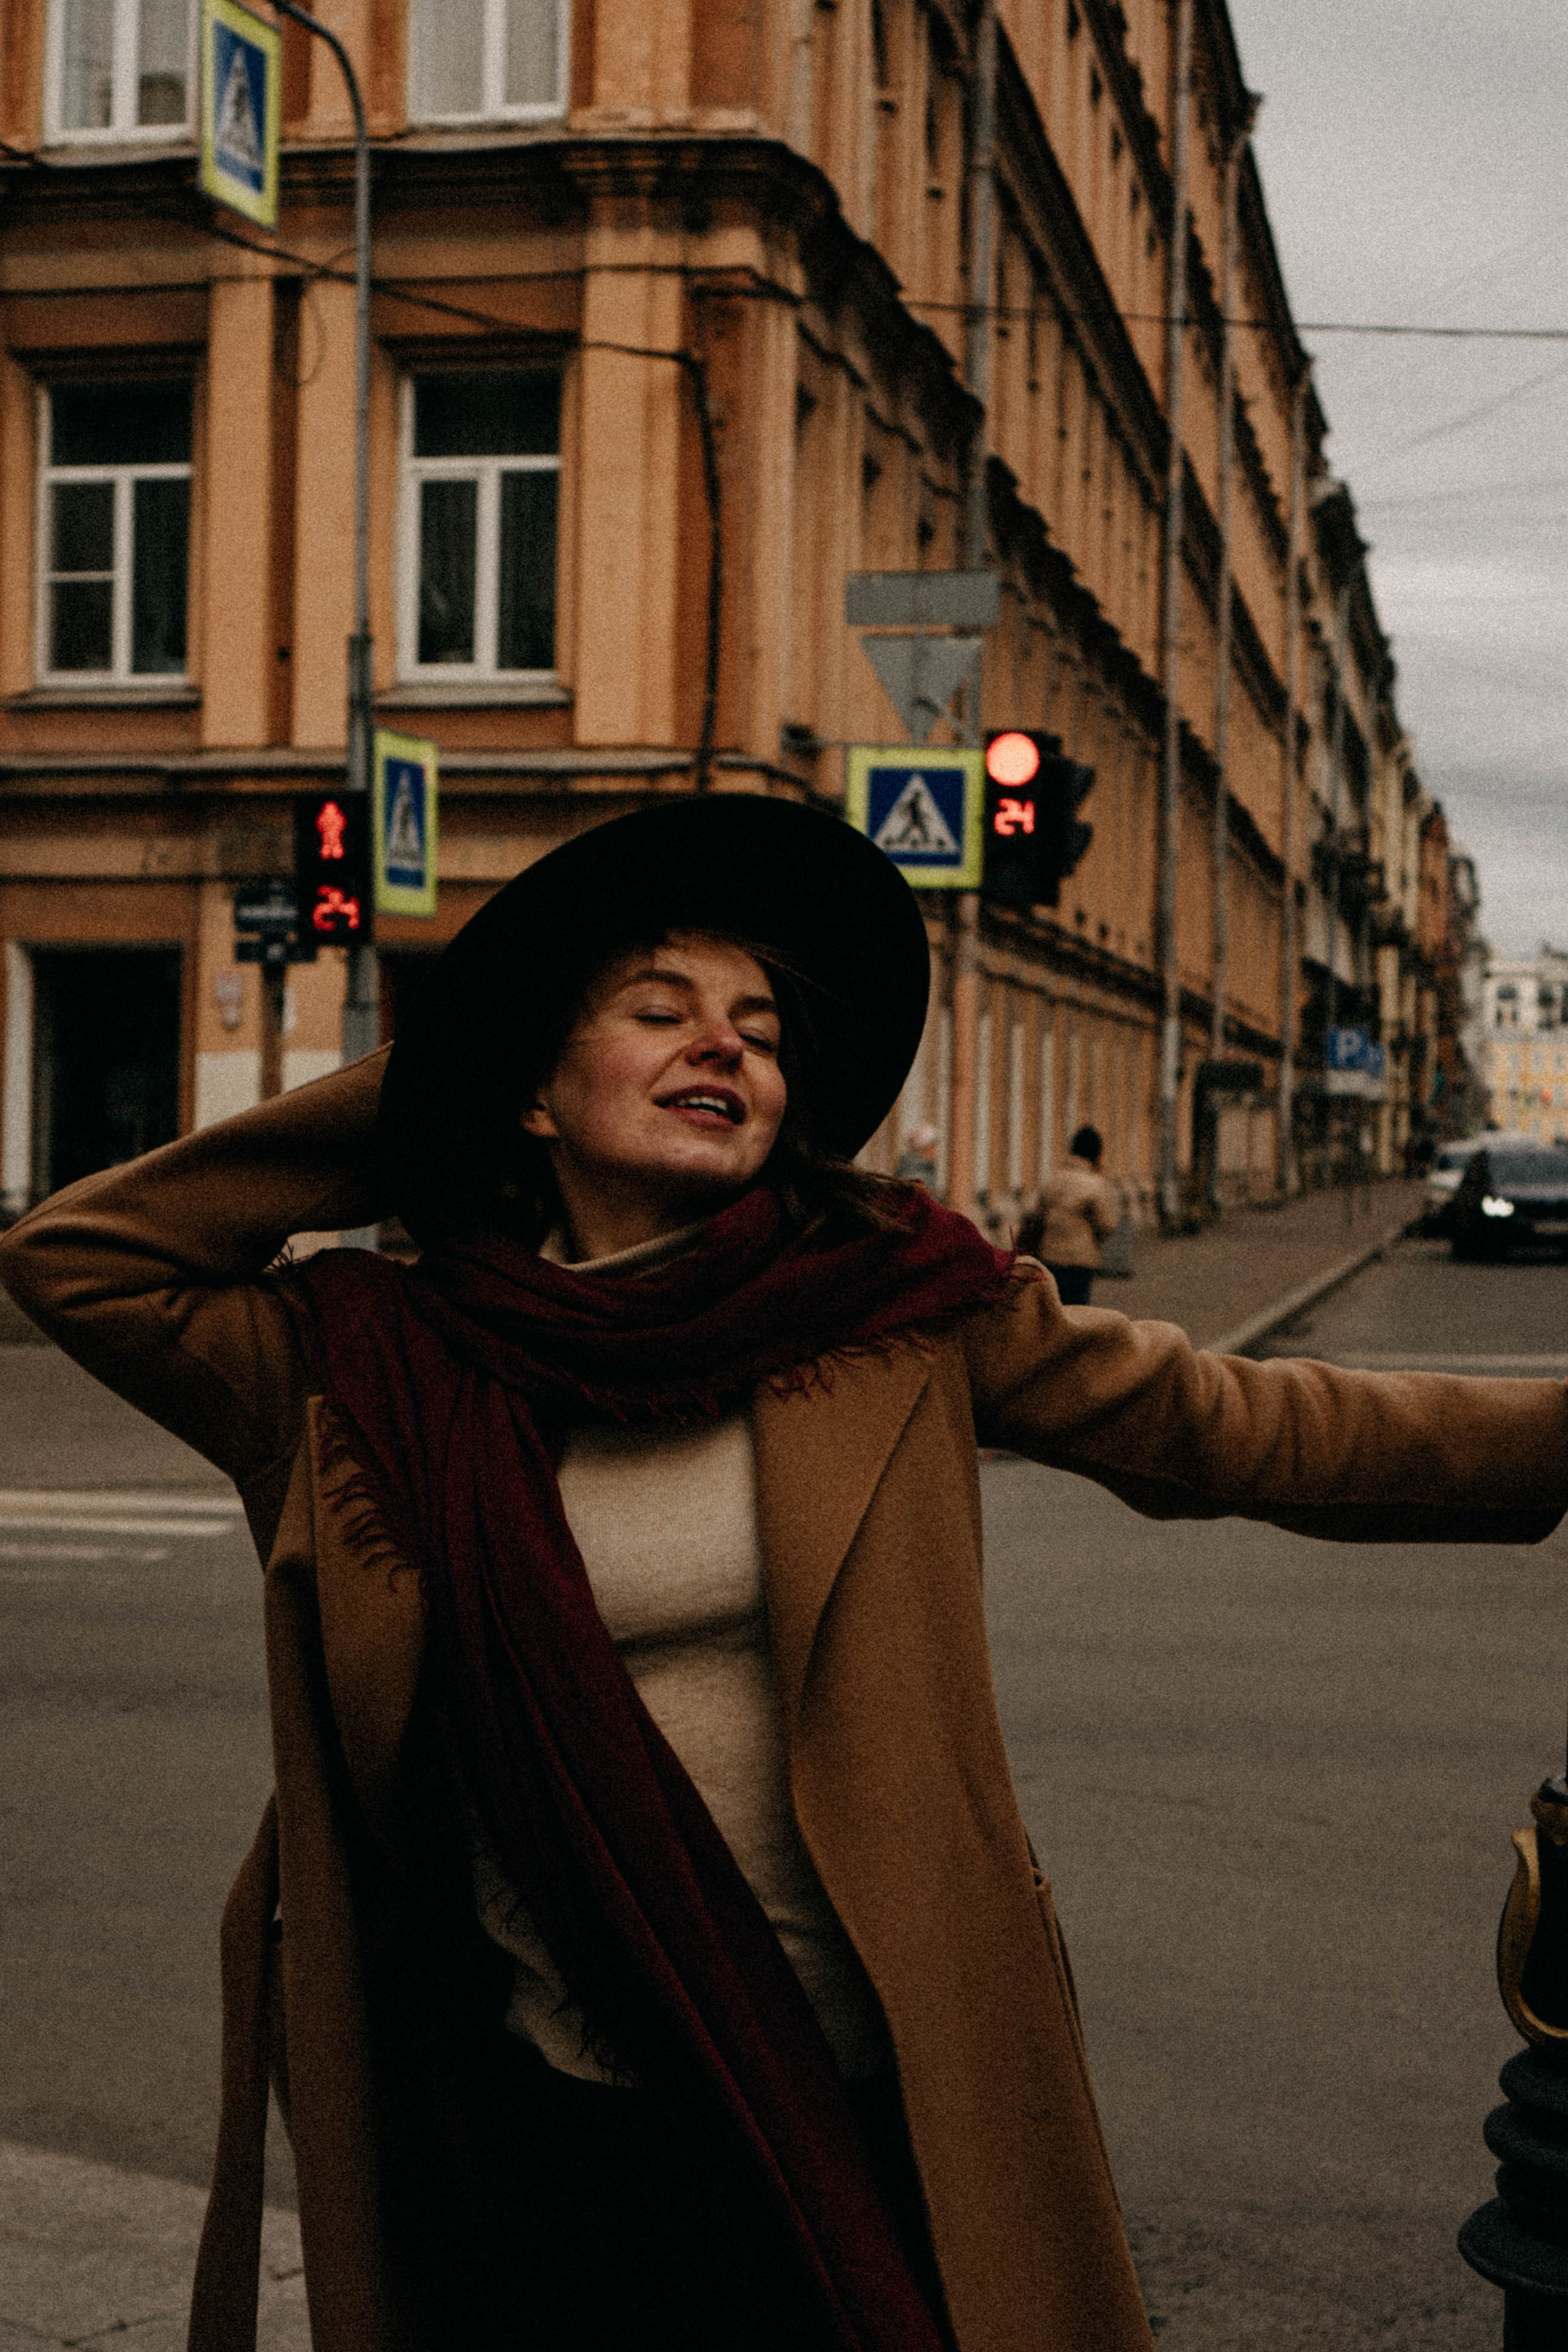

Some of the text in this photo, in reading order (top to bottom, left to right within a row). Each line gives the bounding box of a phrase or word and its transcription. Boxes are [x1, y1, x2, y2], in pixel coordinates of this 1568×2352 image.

[993, 797, 1035, 836] 24
[312, 886, 360, 931] 24
[1336, 1029, 1361, 1062] P
